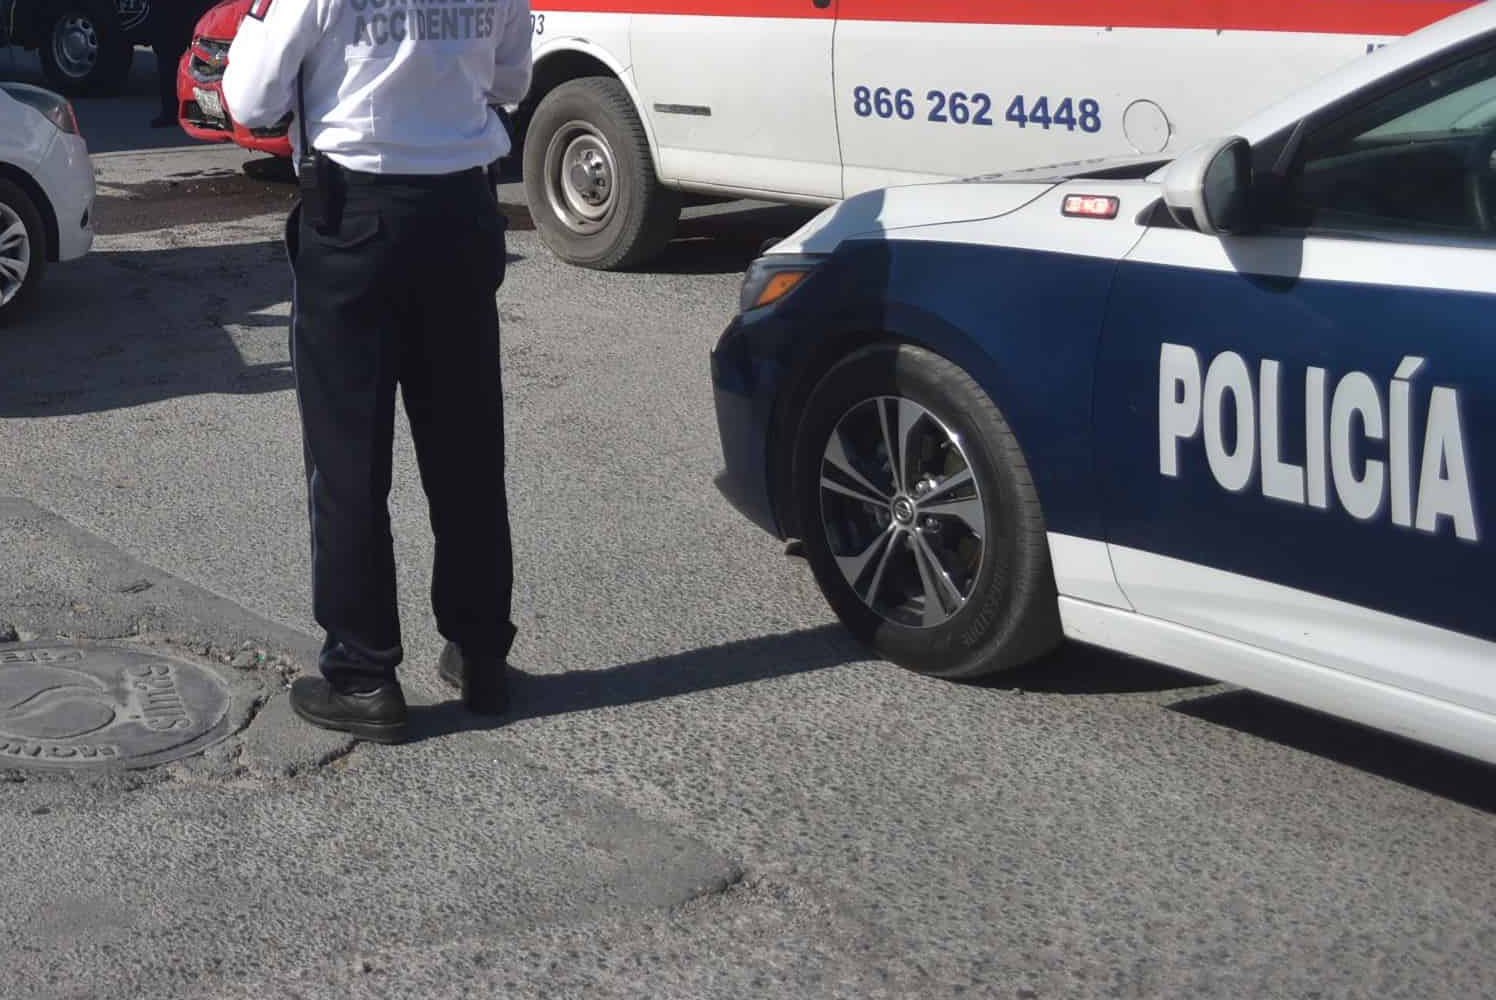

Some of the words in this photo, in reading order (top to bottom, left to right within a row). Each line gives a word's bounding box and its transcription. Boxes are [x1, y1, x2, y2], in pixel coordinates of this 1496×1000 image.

[353, 8, 495, 45] ACCIDENTES
[853, 85, 915, 120] 866
[926, 89, 993, 126] 262
[1005, 94, 1102, 133] 4448
[1159, 342, 1479, 541] POLICÍA
